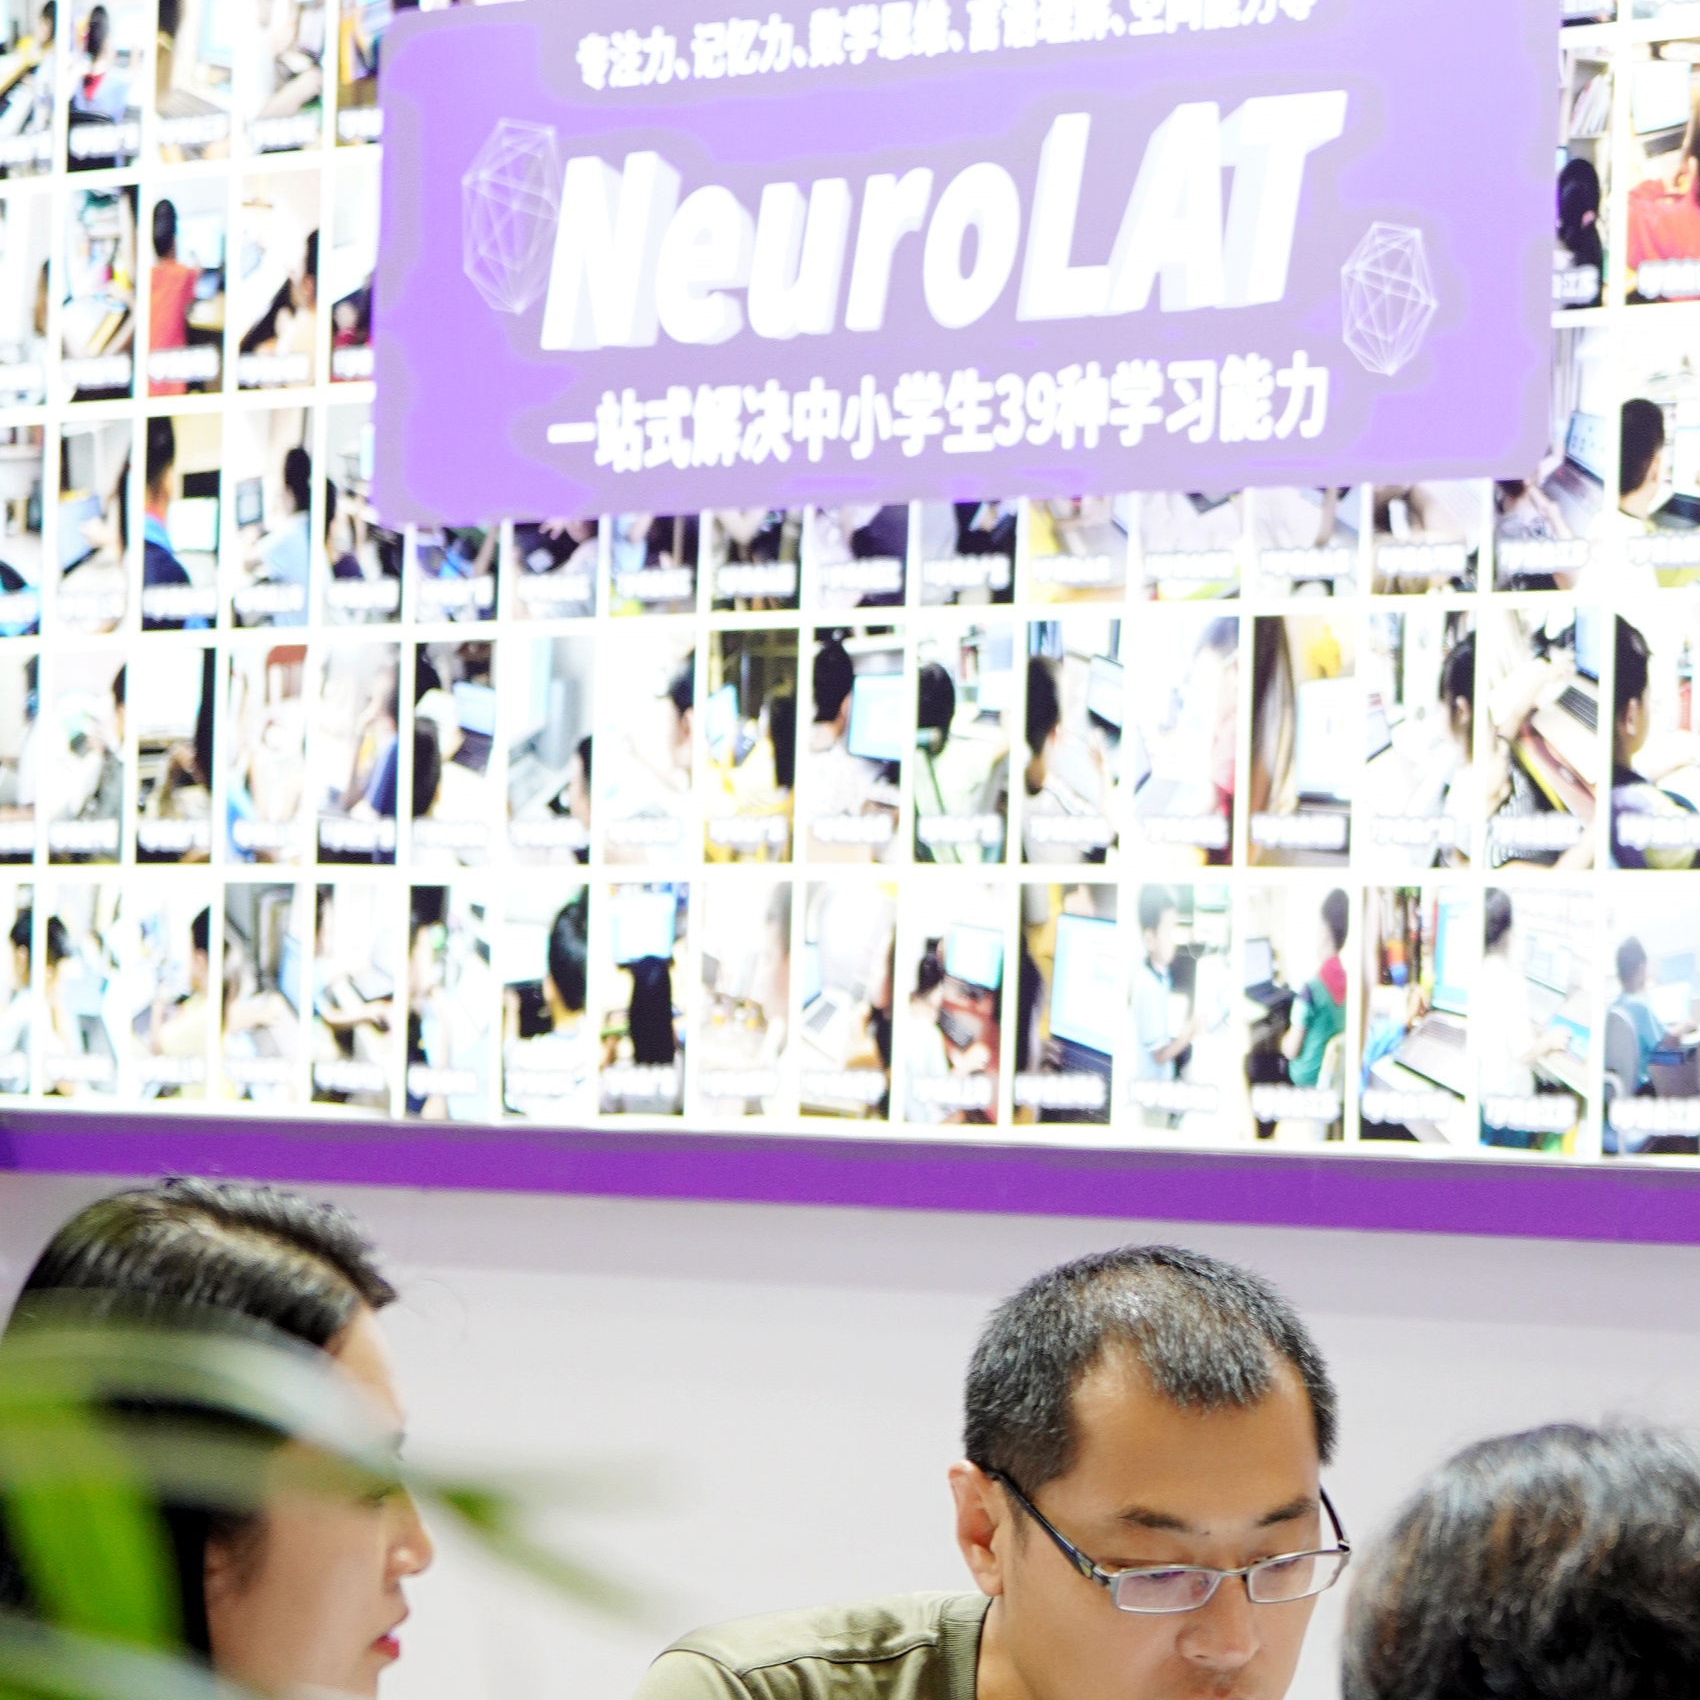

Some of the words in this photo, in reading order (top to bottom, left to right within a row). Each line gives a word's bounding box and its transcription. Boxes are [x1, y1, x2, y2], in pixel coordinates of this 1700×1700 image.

[540, 90, 1348, 351] NeuroLAT
[546, 350, 1329, 473] 一站式解决中小学生39种学习能力
